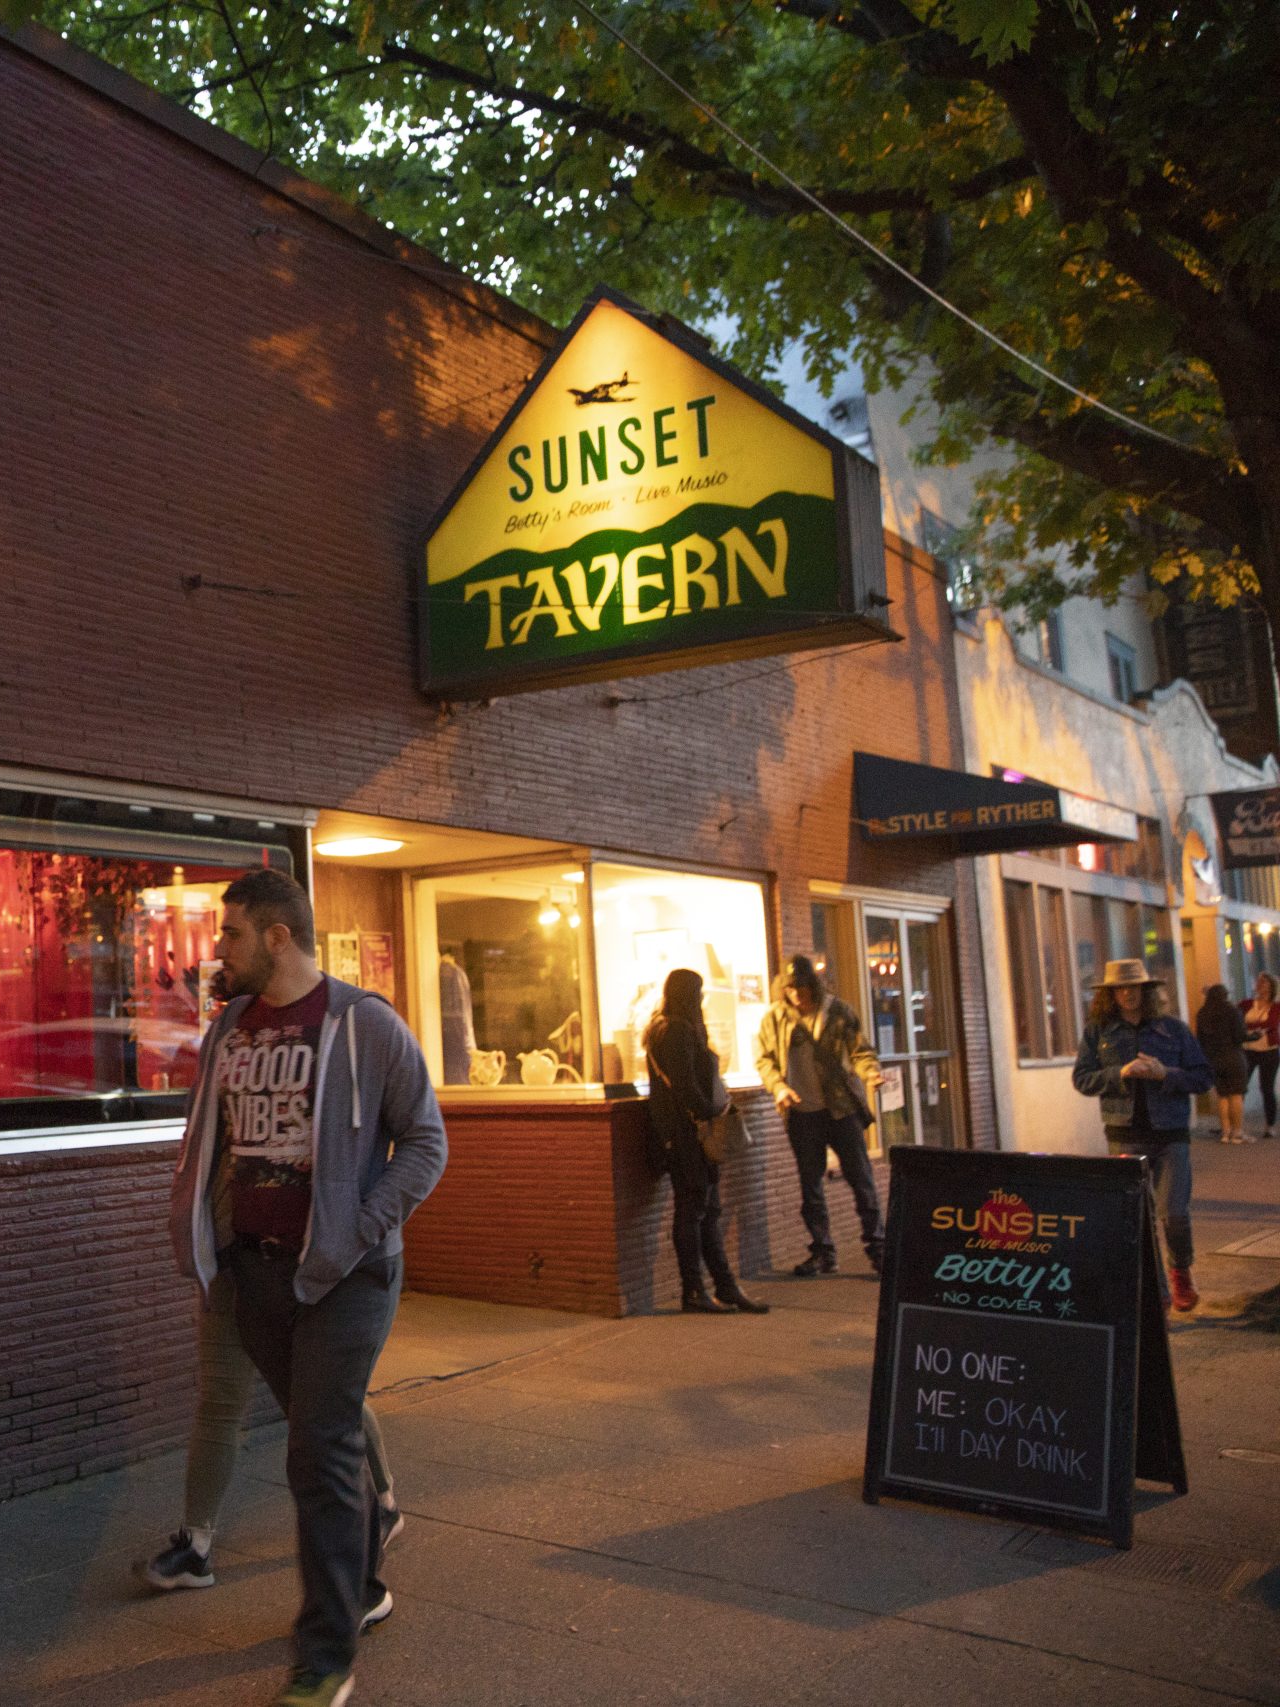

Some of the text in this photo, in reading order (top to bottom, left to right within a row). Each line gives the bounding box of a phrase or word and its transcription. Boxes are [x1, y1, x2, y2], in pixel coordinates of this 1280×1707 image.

[507, 395, 716, 503] SUNSET
[504, 472, 729, 534] Betty's Room Live Music
[464, 518, 790, 650] TAVERN
[888, 811, 947, 833] STYLE
[977, 799, 1056, 825] RYTHER
[228, 1044, 313, 1094] GOOD
[226, 1093, 312, 1142] VIBES
[988, 1187, 1023, 1206] The
[930, 1206, 1085, 1239] SUNSET
[964, 1237, 1052, 1254] LIVE MUSIC
[934, 1253, 1072, 1299] Betty's
[942, 1291, 1043, 1313] NO COVER
[915, 1344, 1026, 1385] NO ONE:
[916, 1387, 966, 1418] ME:
[959, 1429, 1006, 1461] DAY
